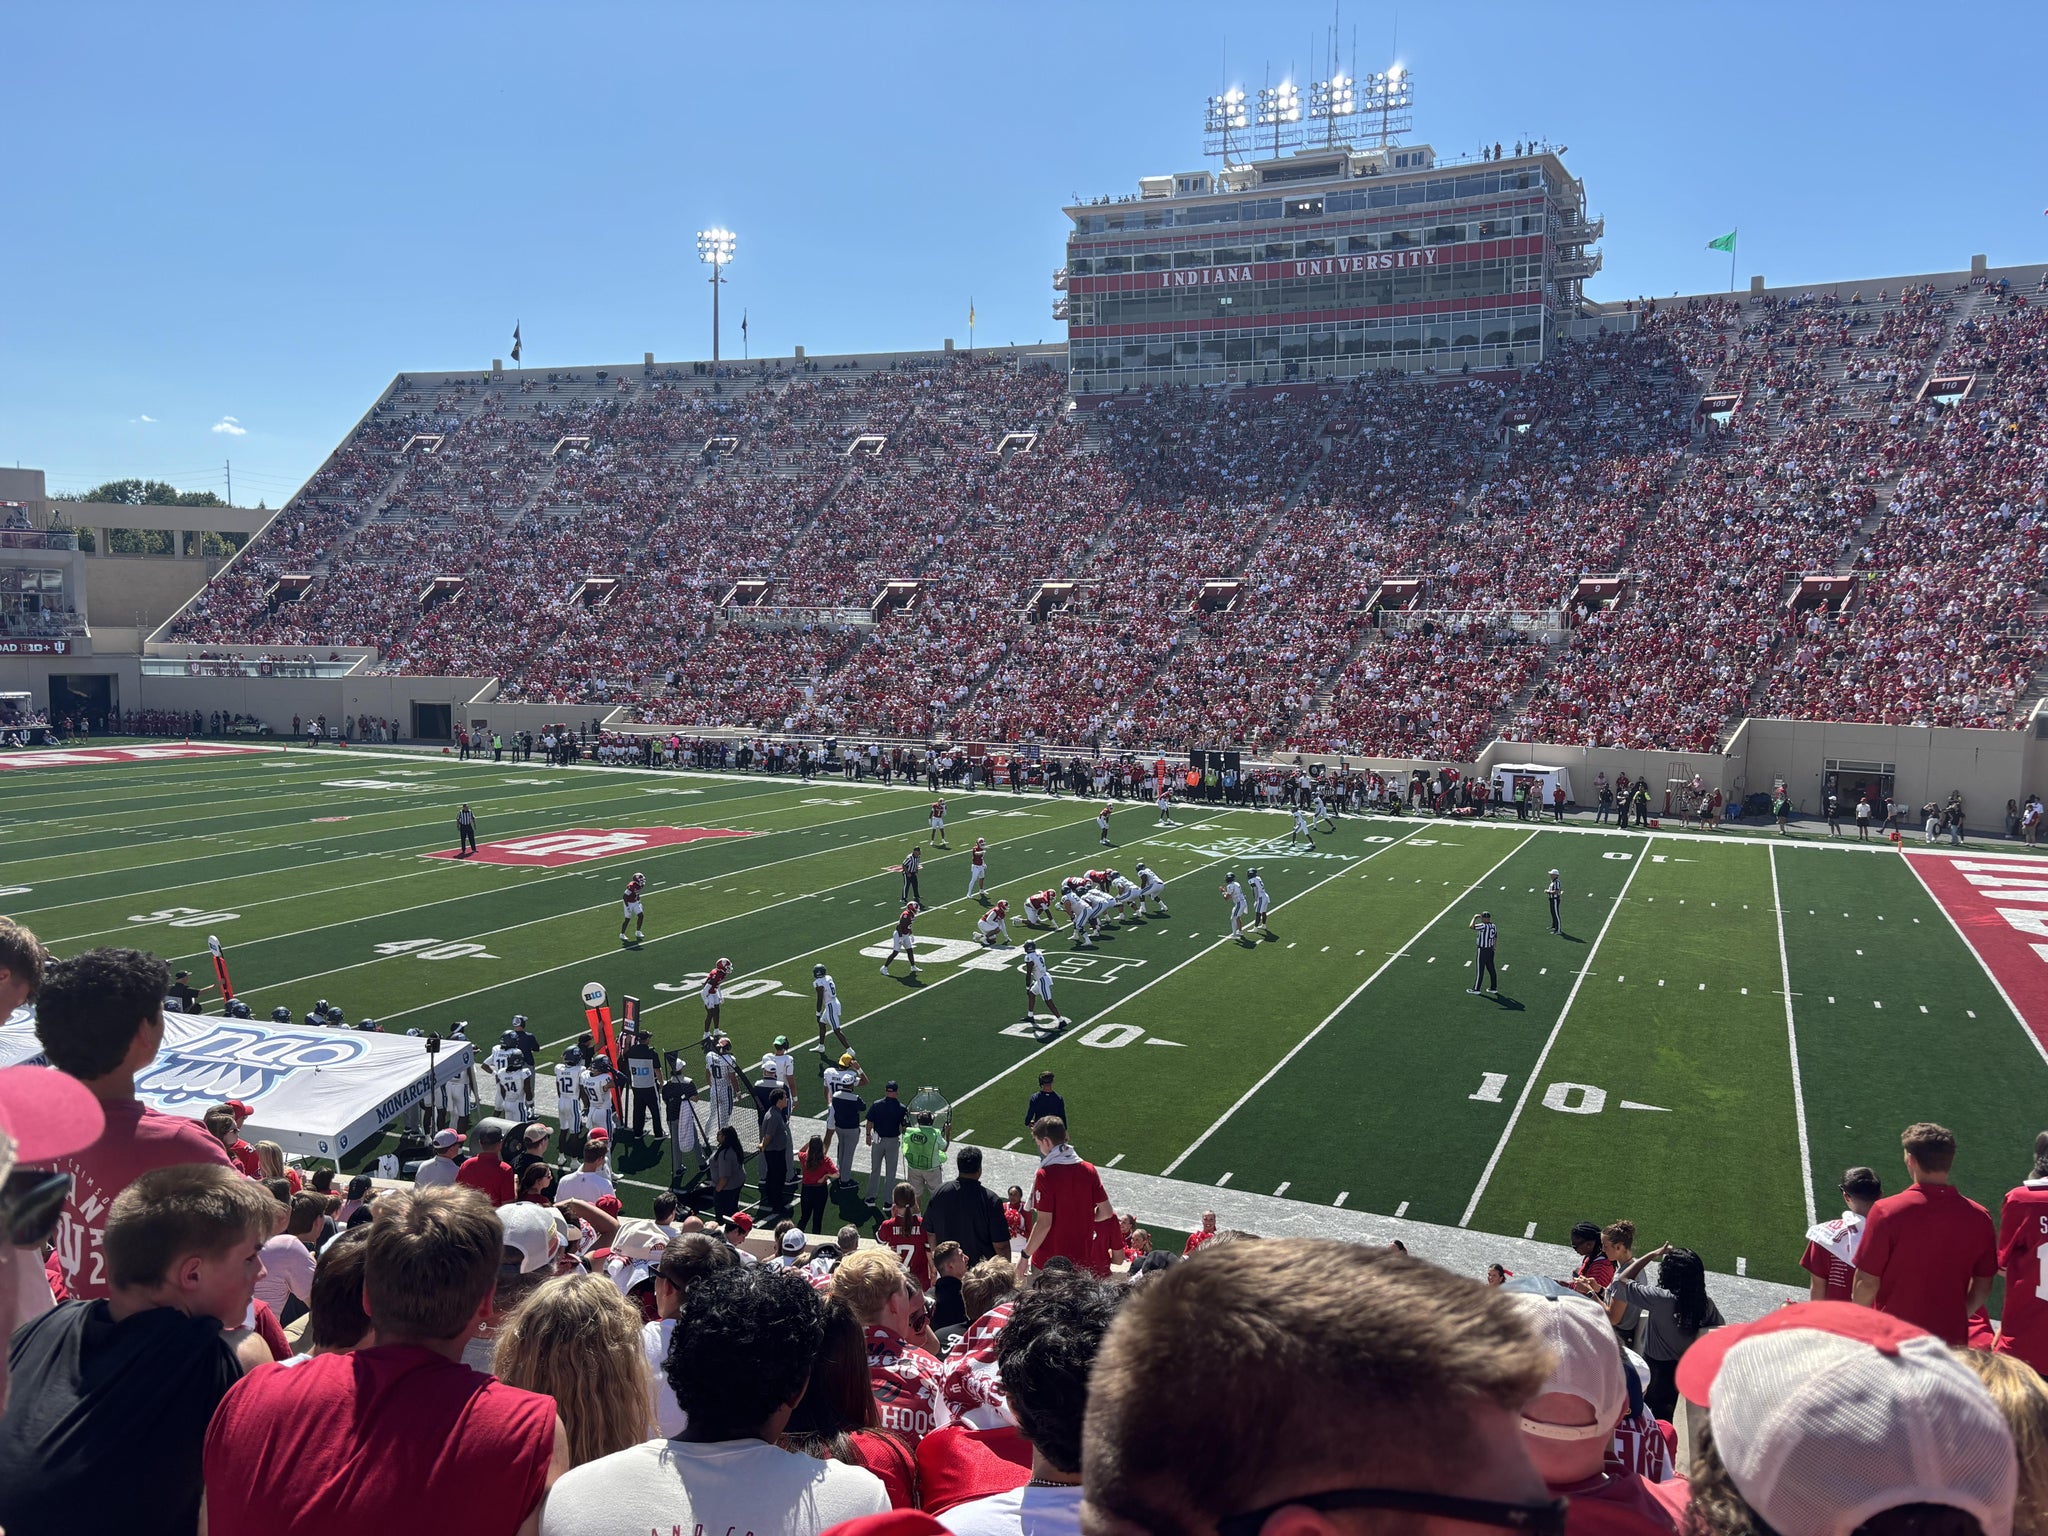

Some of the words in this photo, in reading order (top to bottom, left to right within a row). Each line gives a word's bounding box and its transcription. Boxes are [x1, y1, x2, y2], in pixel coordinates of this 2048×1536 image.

[1162, 266, 1253, 287] INDIANA
[1296, 248, 1438, 276] UNIVERSITY
[1940, 381, 1958, 389] 110
[1712, 399, 1726, 407] 109
[1513, 413, 1527, 421] 108
[1334, 423, 1347, 431] 107
[1818, 582, 1832, 591] 10
[0, 644, 17, 652] AD
[205, 668, 248, 677] TOMORROW
[127, 907, 241, 928] 50
[373, 937, 488, 961] 40
[653, 972, 783, 1000] 30
[583, 990, 603, 1002] B1G
[999, 1013, 1147, 1049] 20
[631, 1065, 650, 1076] B1G
[505, 1081, 518, 1093] 14
[559, 1077, 574, 1094] 12
[376, 1072, 438, 1125] MONARCHS
[584, 1086, 599, 1102] 19
[1469, 1072, 1608, 1115] 10
[69, 1158, 111, 1205] CRIMSO
[892, 1226, 921, 1236] INNA
